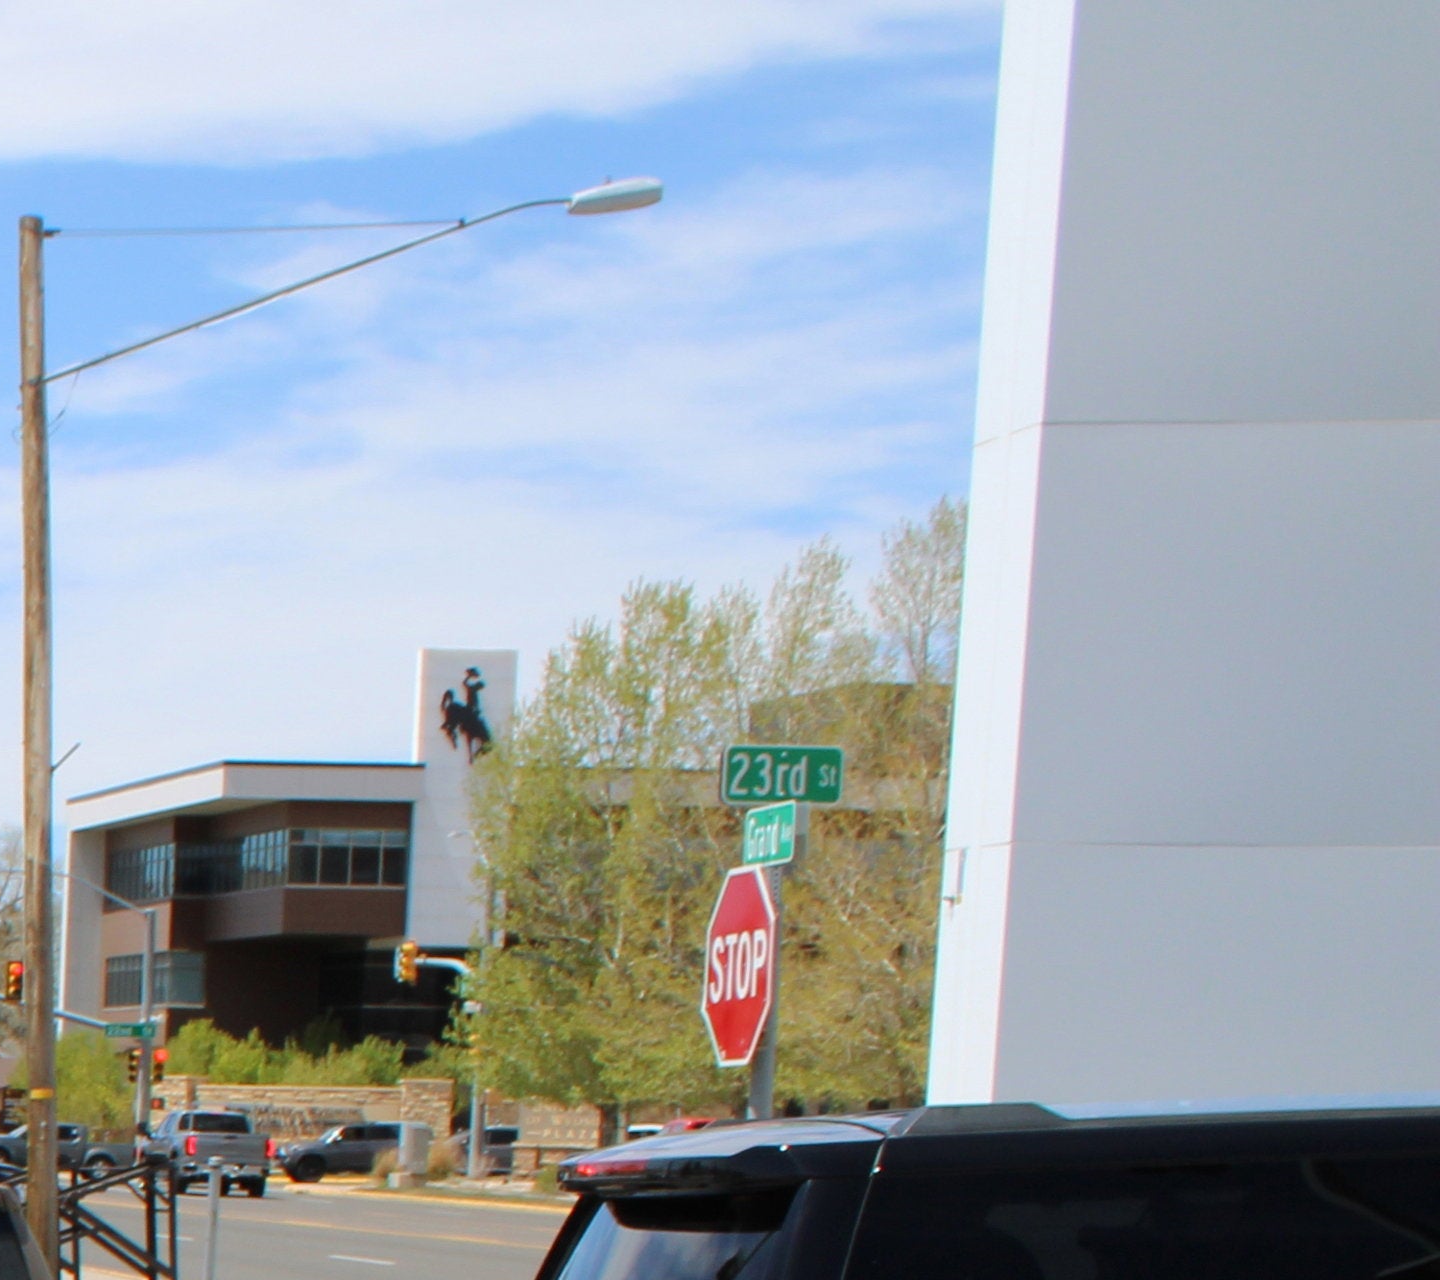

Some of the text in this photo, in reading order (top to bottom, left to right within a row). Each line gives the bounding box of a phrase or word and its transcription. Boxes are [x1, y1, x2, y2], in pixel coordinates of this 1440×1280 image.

[730, 752, 837, 798] 23rd St
[709, 929, 768, 1004] STOP
[543, 1135, 598, 1149] PLAZA
